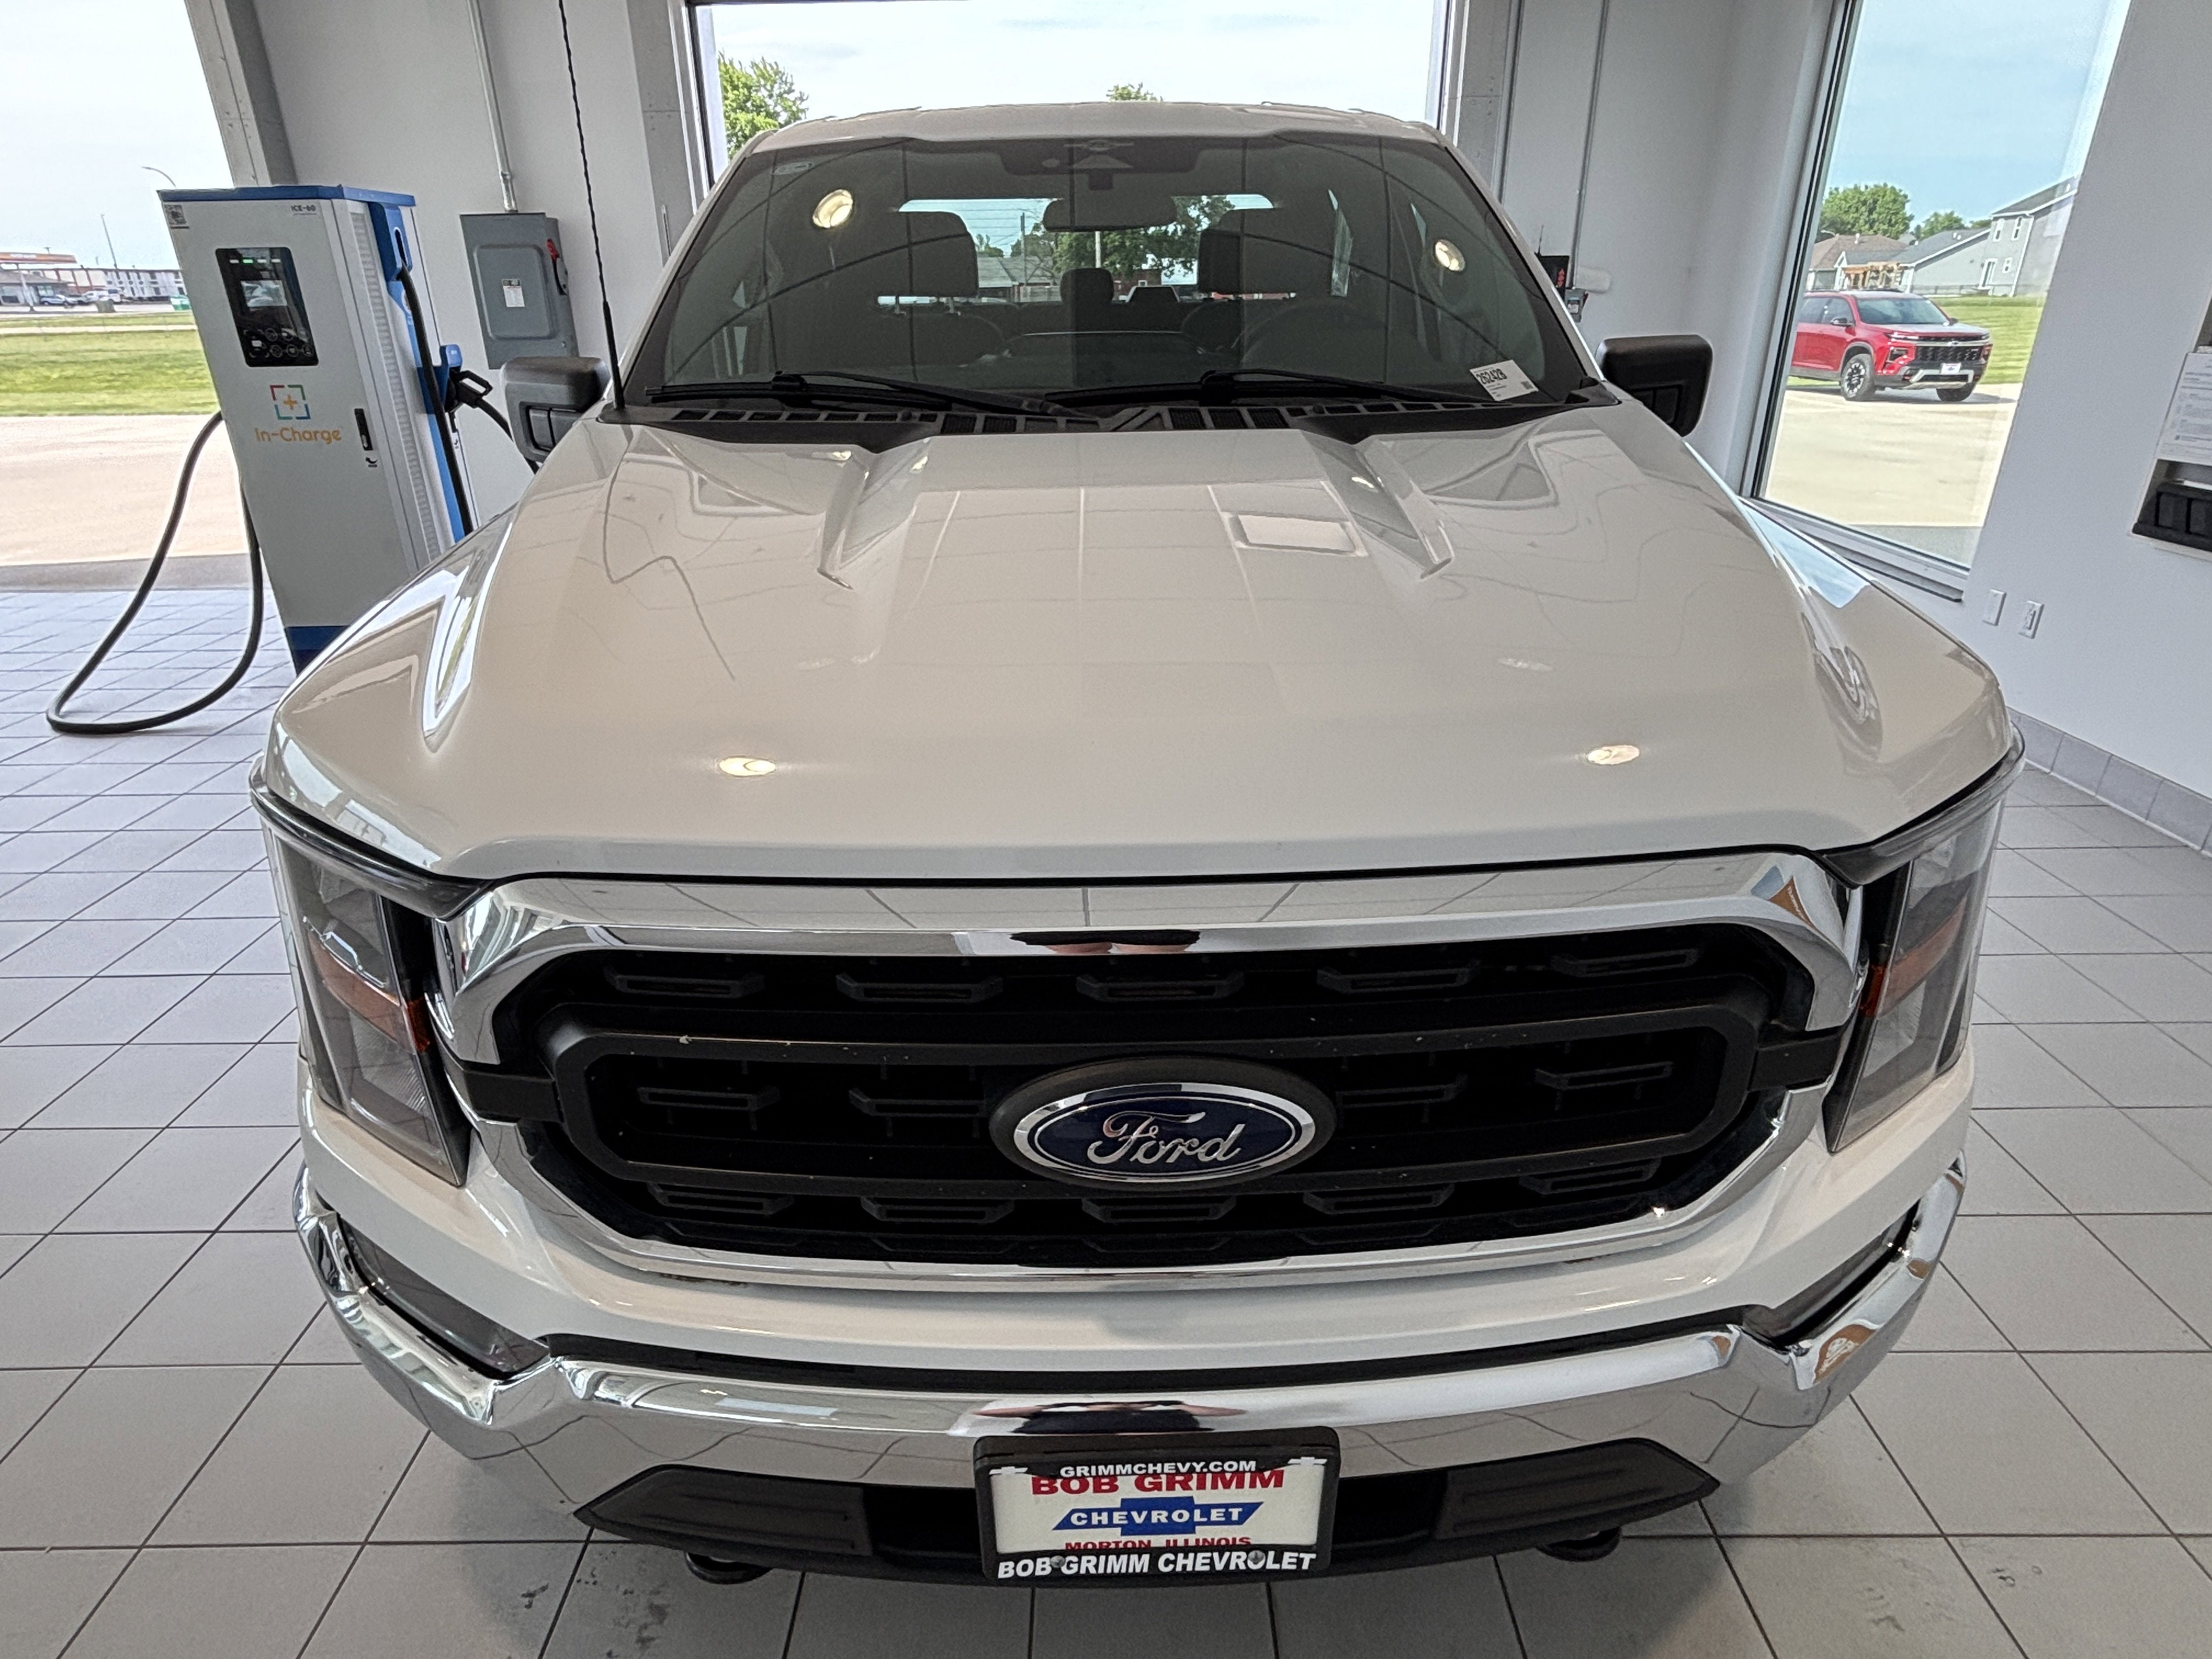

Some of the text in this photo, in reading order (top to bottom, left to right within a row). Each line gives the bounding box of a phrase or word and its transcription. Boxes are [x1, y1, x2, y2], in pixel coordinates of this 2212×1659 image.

[255, 426, 342, 445] In-Charge
[1087, 1110, 1245, 1164] Ford
[1060, 1460, 1256, 1478] GRIMMCHEVY.COM
[1031, 1469, 1284, 1495] BOB GRIMM
[1070, 1508, 1243, 1526] CHEVROLET
[997, 1557, 1052, 1579] BOB
[1060, 1554, 1150, 1575] GRIMM
